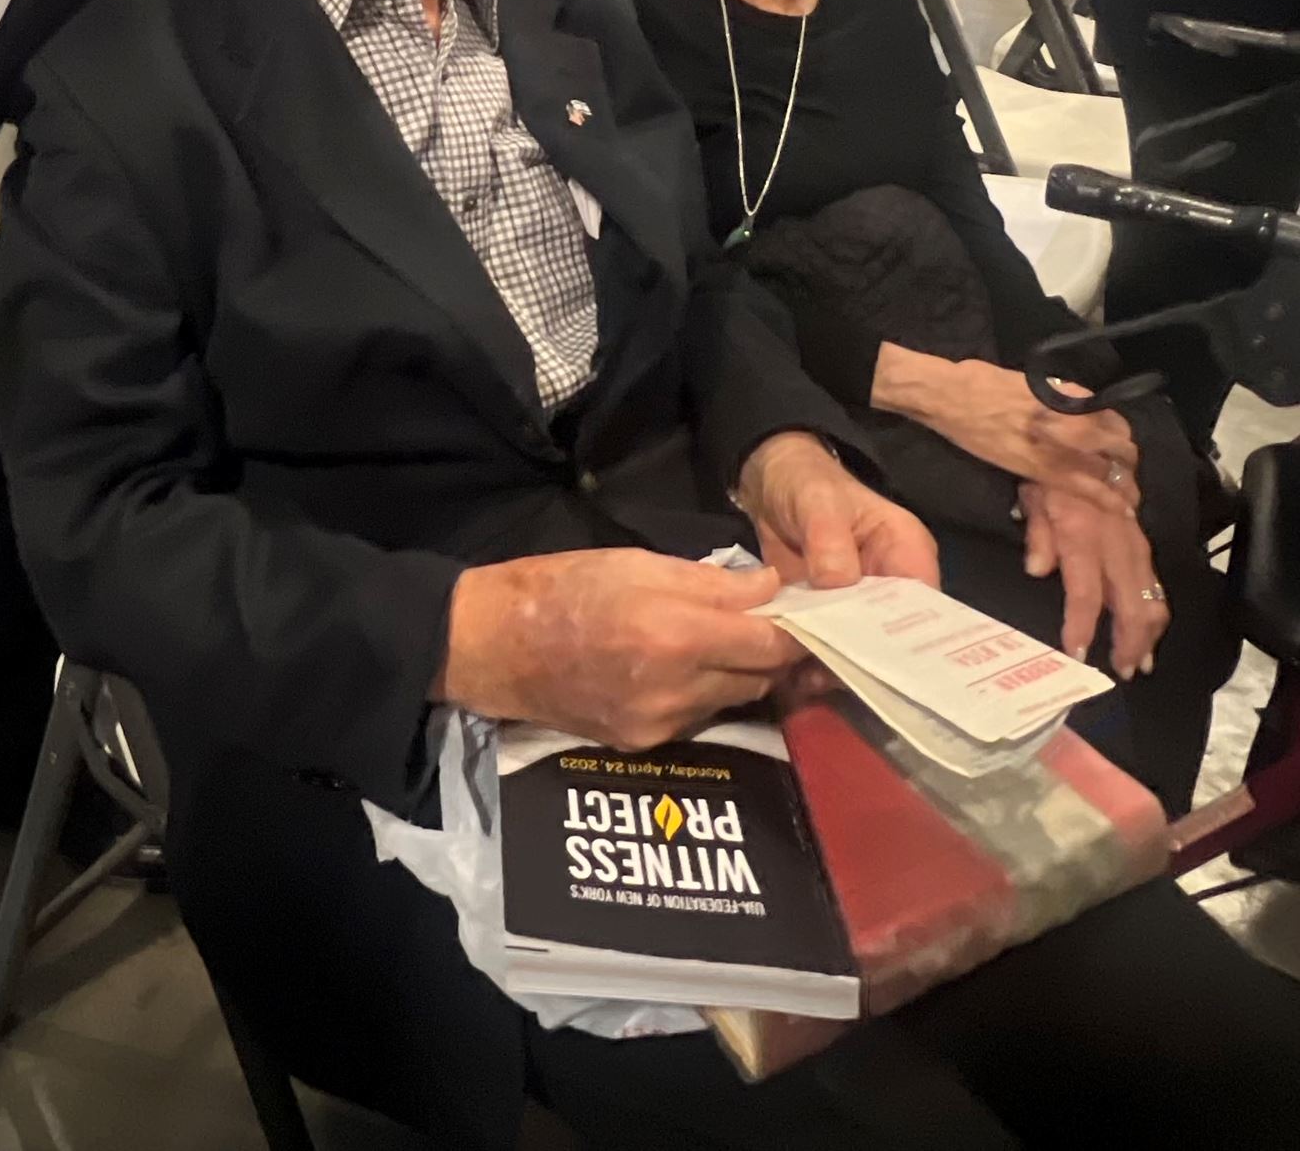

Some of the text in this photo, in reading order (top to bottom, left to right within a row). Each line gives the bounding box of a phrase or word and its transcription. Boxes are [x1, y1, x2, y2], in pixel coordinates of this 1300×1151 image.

[559, 757, 731, 781] Monday, April 24, 2023
[565, 835, 761, 895] WITNESS
[569, 884, 766, 916] UJA-FEDERATION OF NEW YORK'S
